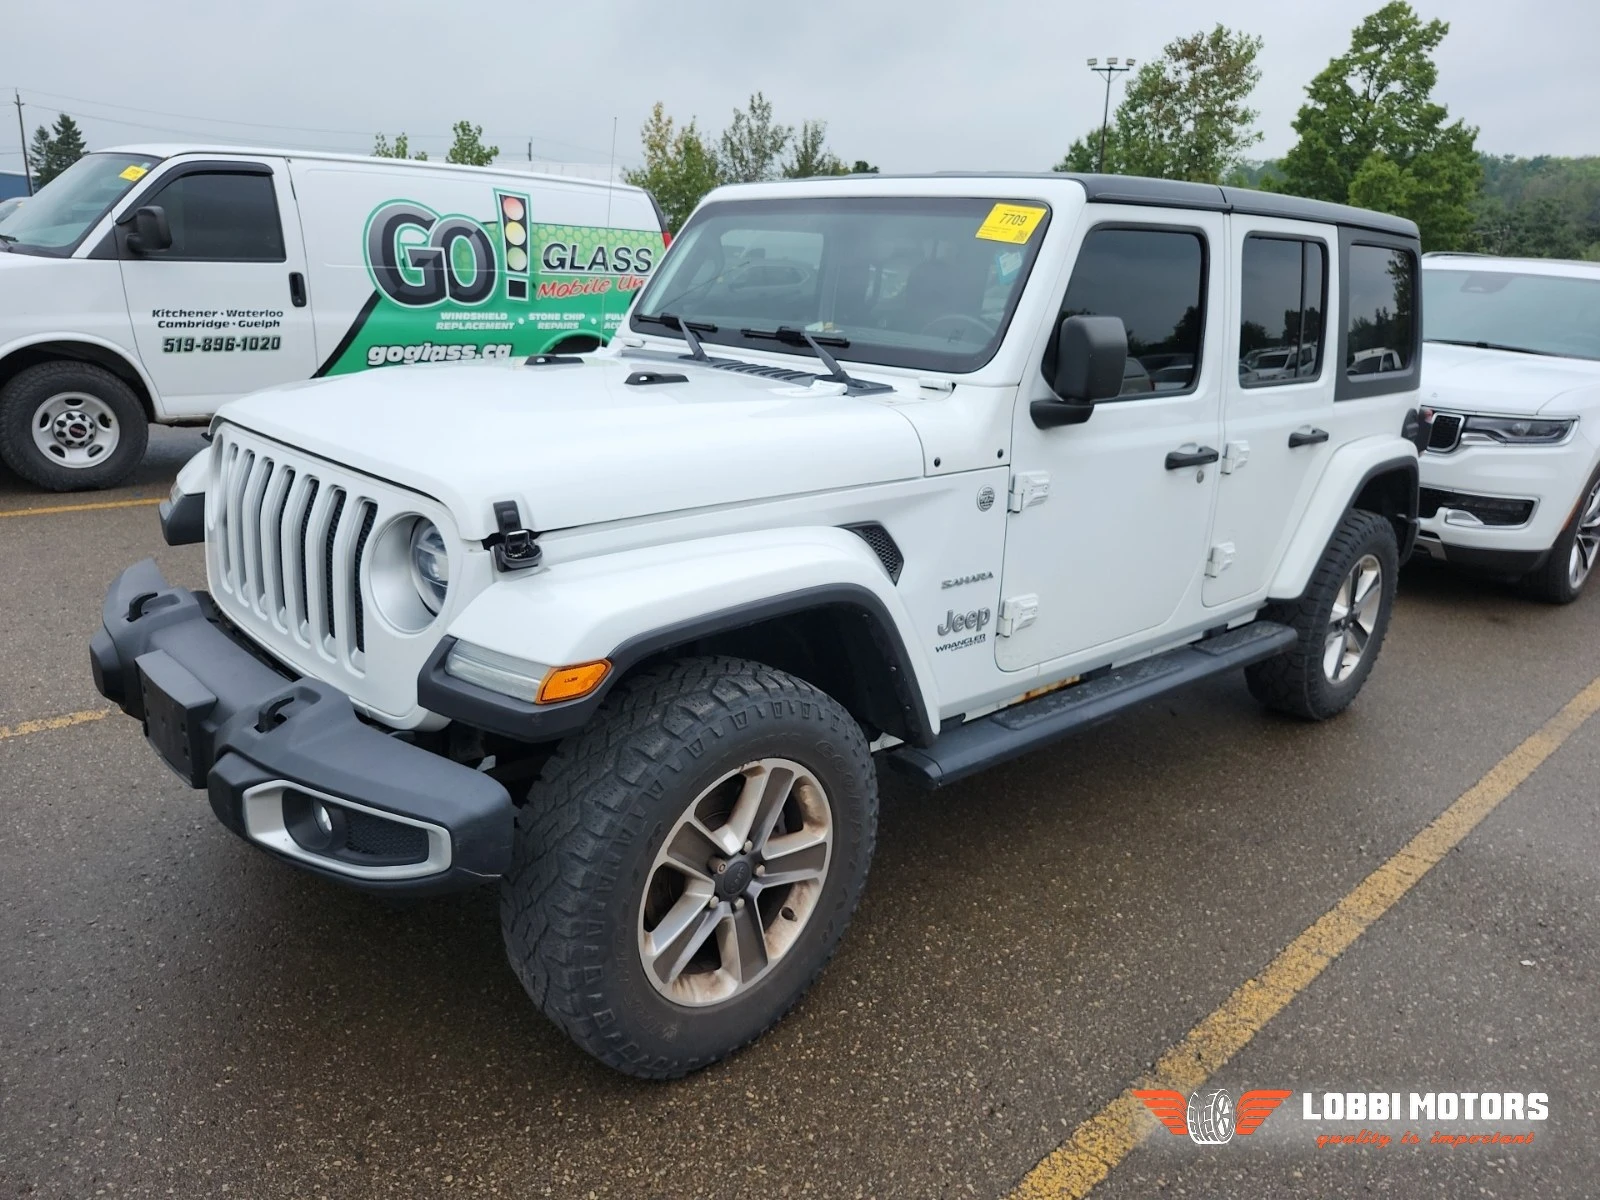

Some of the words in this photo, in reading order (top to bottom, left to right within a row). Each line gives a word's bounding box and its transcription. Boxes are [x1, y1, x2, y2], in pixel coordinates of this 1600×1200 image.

[999, 213, 1028, 226] 7709
[542, 242, 652, 273] GLASS
[537, 279, 611, 299] Mobile
[152, 309, 218, 318] Kitchener
[226, 309, 284, 318] Waterloo
[440, 312, 508, 320] WINDSHIELD
[529, 312, 561, 321] STONE
[562, 312, 586, 321] CHIP
[157, 319, 230, 330] Cambridge
[238, 319, 280, 329] Guelph
[436, 321, 515, 330] REPLACEMENT
[537, 321, 580, 330] REPAIRS
[163, 336, 281, 353] 519-896-1020
[941, 571, 994, 590] SAHARA
[937, 607, 991, 637] Jeep
[935, 633, 986, 653] WRANGLER
